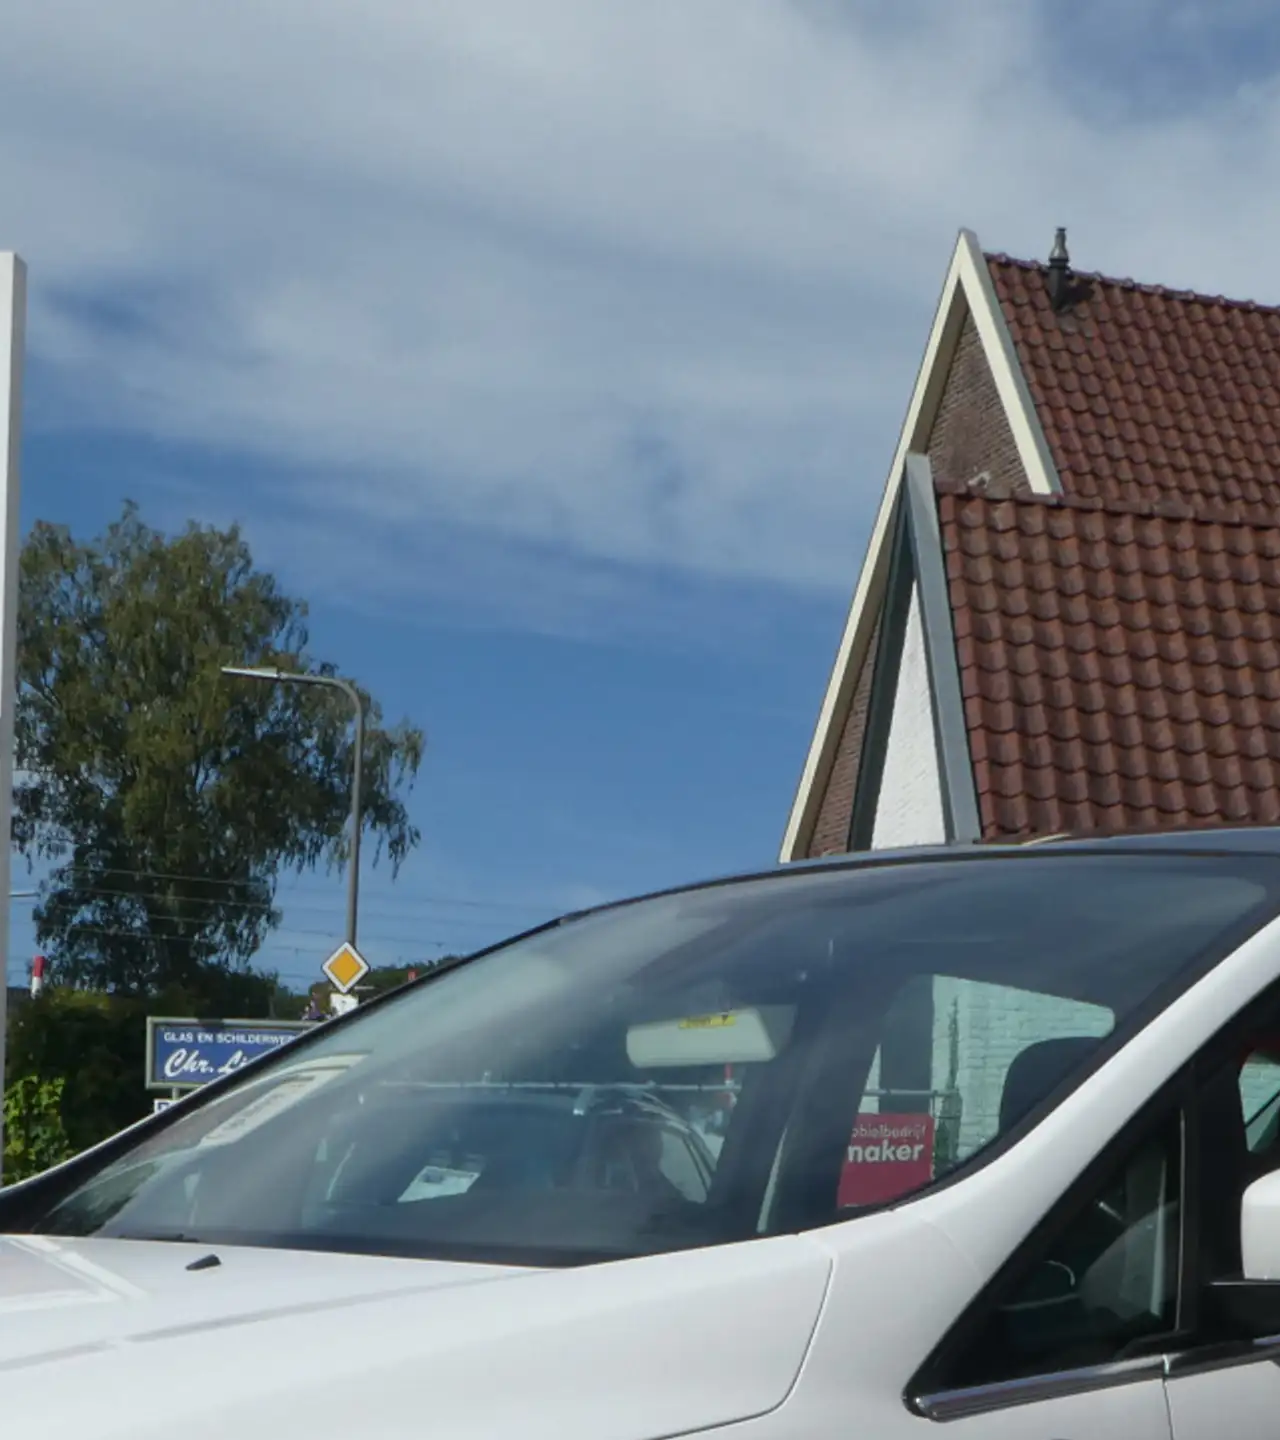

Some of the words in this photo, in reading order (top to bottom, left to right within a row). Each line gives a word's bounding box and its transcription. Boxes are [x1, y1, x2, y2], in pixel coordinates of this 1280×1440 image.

[163, 1032, 193, 1043] GLAS
[197, 1032, 214, 1043] EN
[163, 1048, 215, 1078] Chr.
